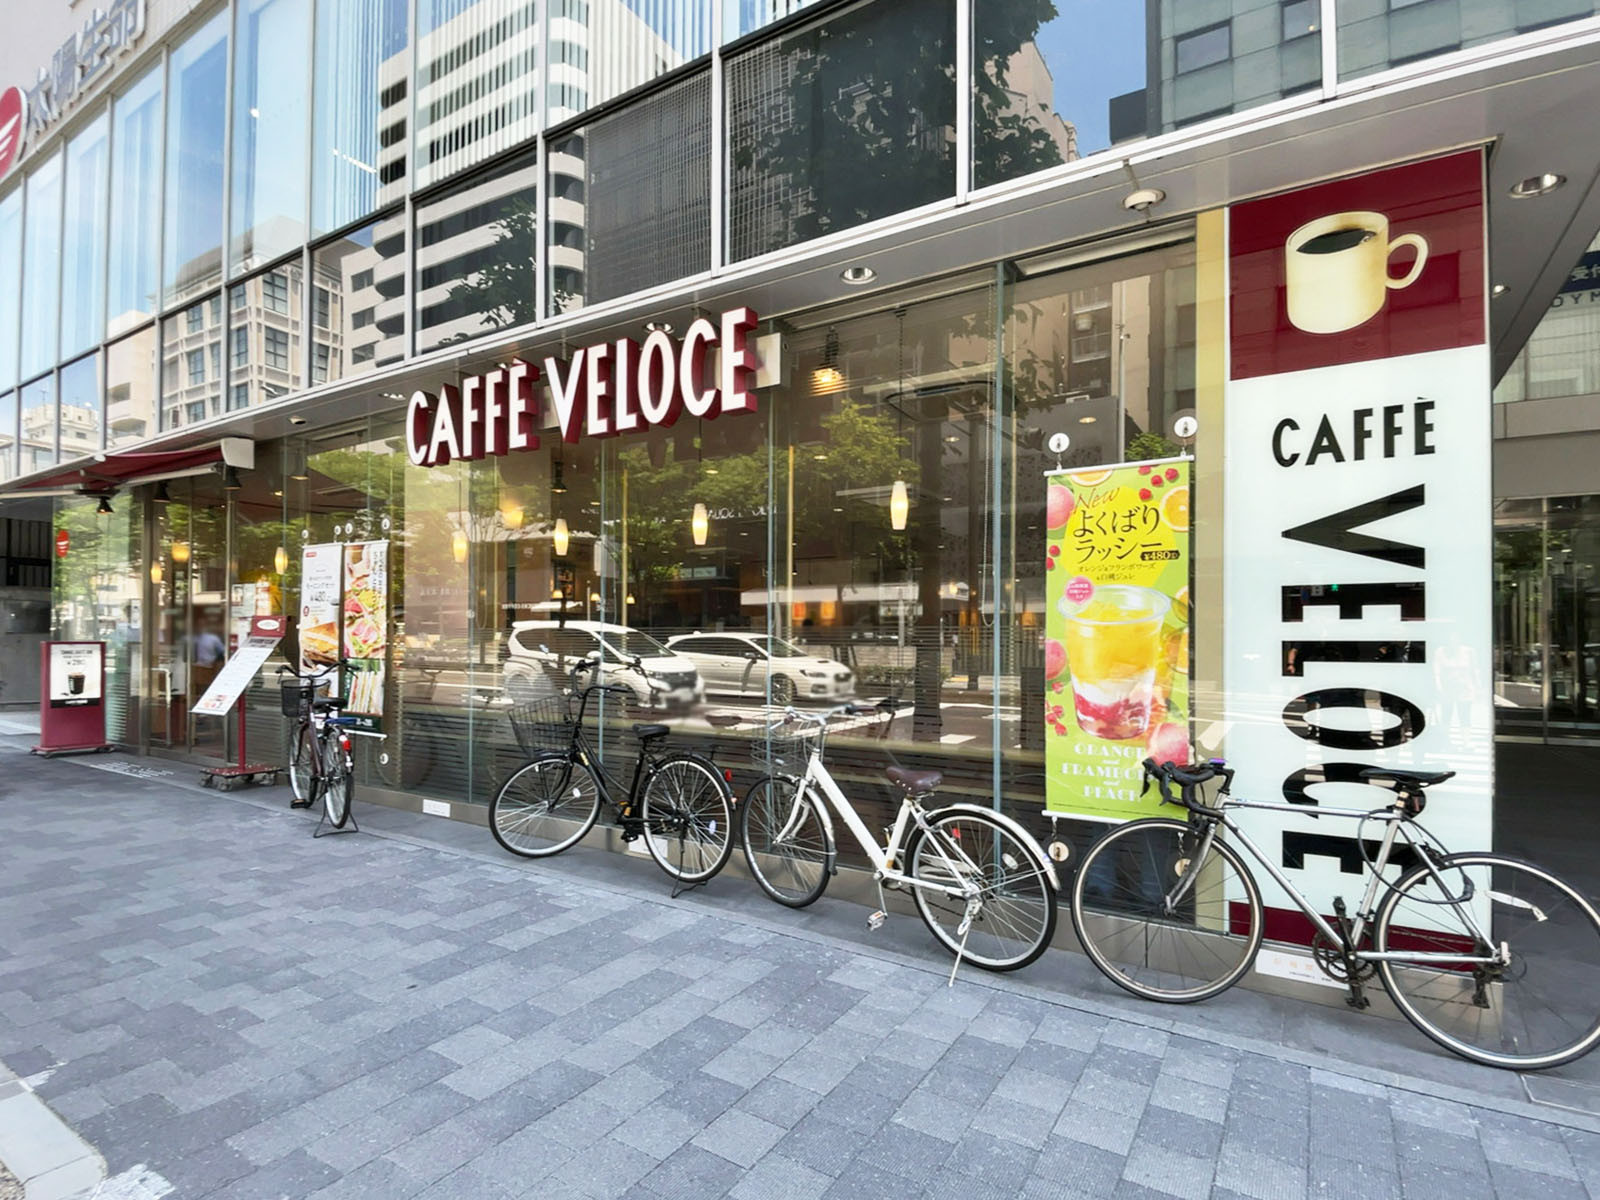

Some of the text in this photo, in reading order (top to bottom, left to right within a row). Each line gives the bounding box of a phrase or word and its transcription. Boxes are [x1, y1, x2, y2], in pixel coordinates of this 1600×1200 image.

[544, 307, 757, 443] VELOCE
[1272, 396, 1436, 468] CAFFÈ
[1073, 487, 1120, 515] New
[1073, 504, 1160, 538] よくばり
[1075, 537, 1162, 564] ラッシー
[1281, 484, 1427, 886] VELOCE
